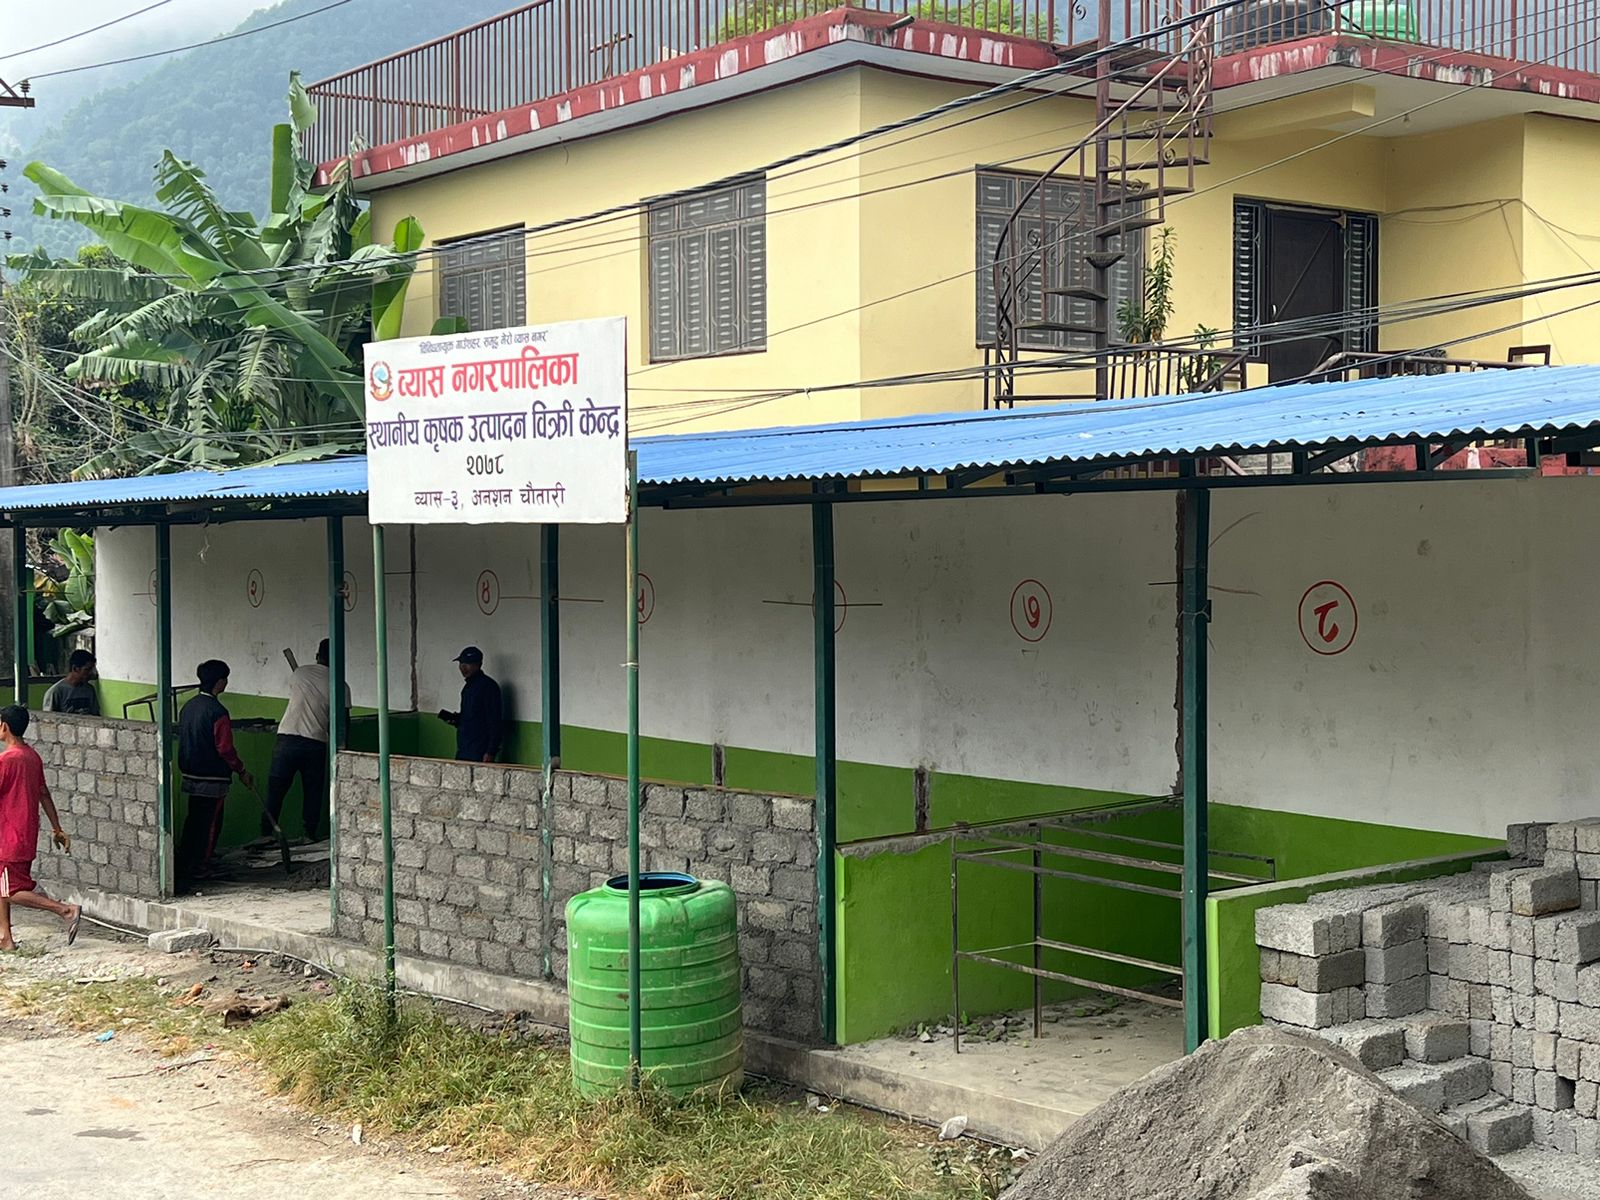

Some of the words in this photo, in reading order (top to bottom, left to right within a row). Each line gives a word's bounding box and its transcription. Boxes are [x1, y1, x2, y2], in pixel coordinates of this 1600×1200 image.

[451, 345, 579, 393] नगरपालिका
[368, 411, 420, 450] स्थानीय
[423, 415, 464, 452] कृषक
[468, 411, 528, 442] उत्पादन
[532, 400, 574, 440] विक्री
[579, 397, 621, 440] केन्द्र
[466, 454, 504, 476] २०७८
[471, 488, 513, 508] अनशन
[519, 481, 566, 508] चौतारी
[1313, 600, 1340, 643] ८
